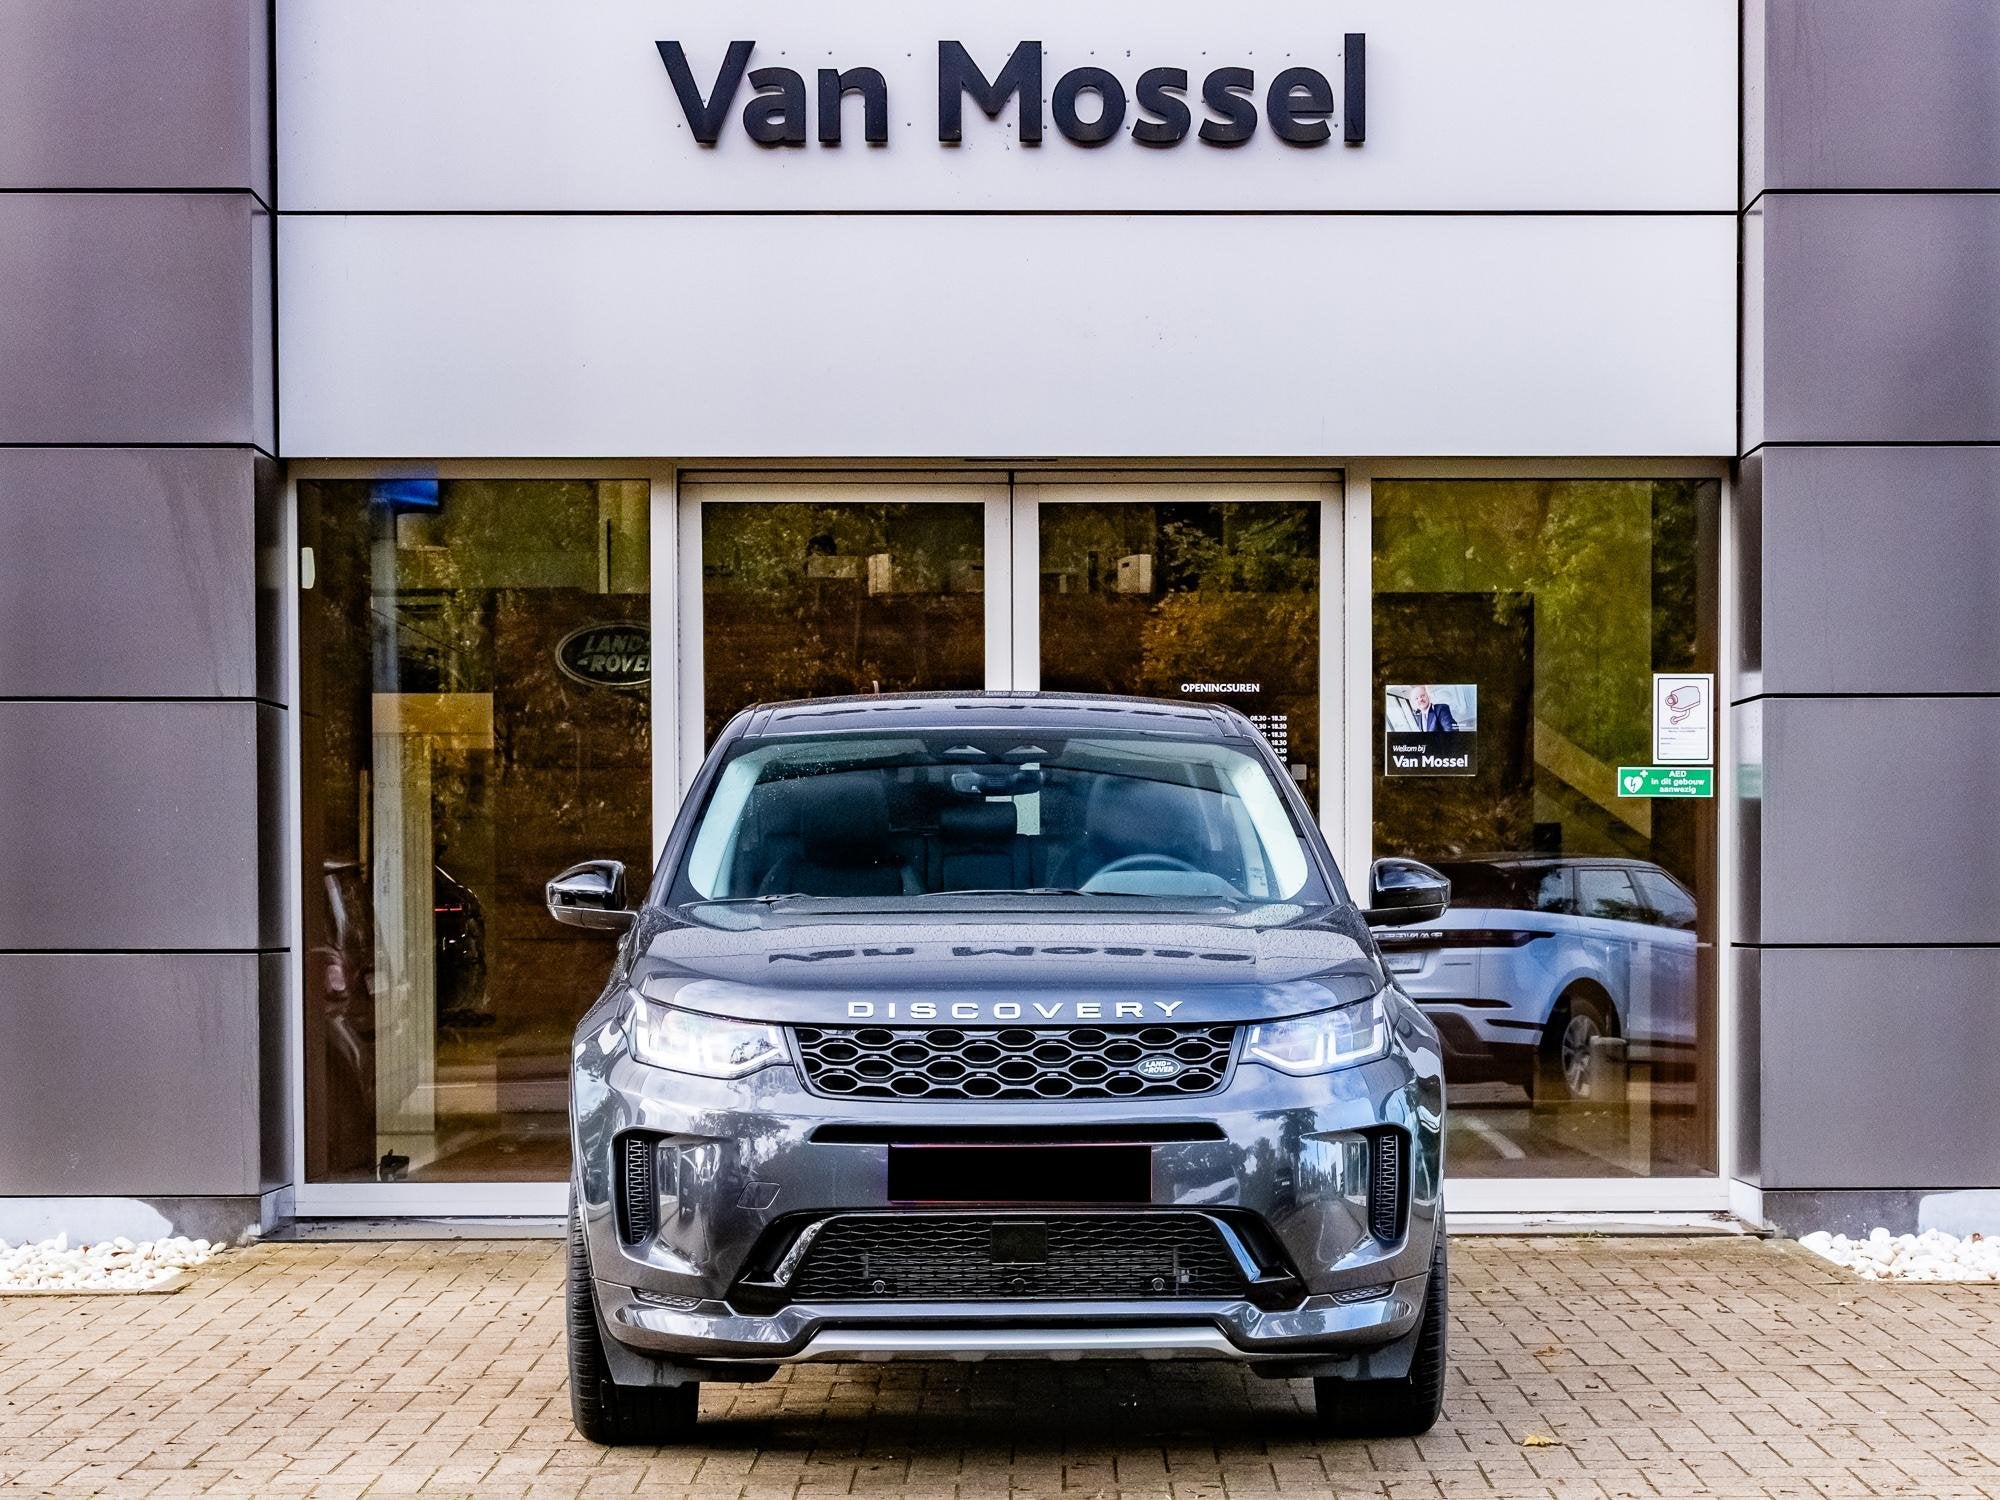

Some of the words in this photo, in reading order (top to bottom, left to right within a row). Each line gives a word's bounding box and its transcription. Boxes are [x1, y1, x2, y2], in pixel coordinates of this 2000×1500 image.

[655, 40, 889, 145] Van
[938, 33, 1366, 145] Mossel
[583, 635, 642, 653] LAND
[589, 654, 650, 672] ROVE
[1181, 683, 1260, 693] OPENINGSUREN
[1393, 744, 1417, 752] Welkom
[1418, 744, 1426, 754] bij
[1393, 755, 1418, 768] Van
[1422, 754, 1469, 768] Mossel
[1673, 778, 1705, 787] gebouw
[1659, 786, 1697, 795] aanwezig
[848, 1001, 1183, 1019] DISCOVERY
